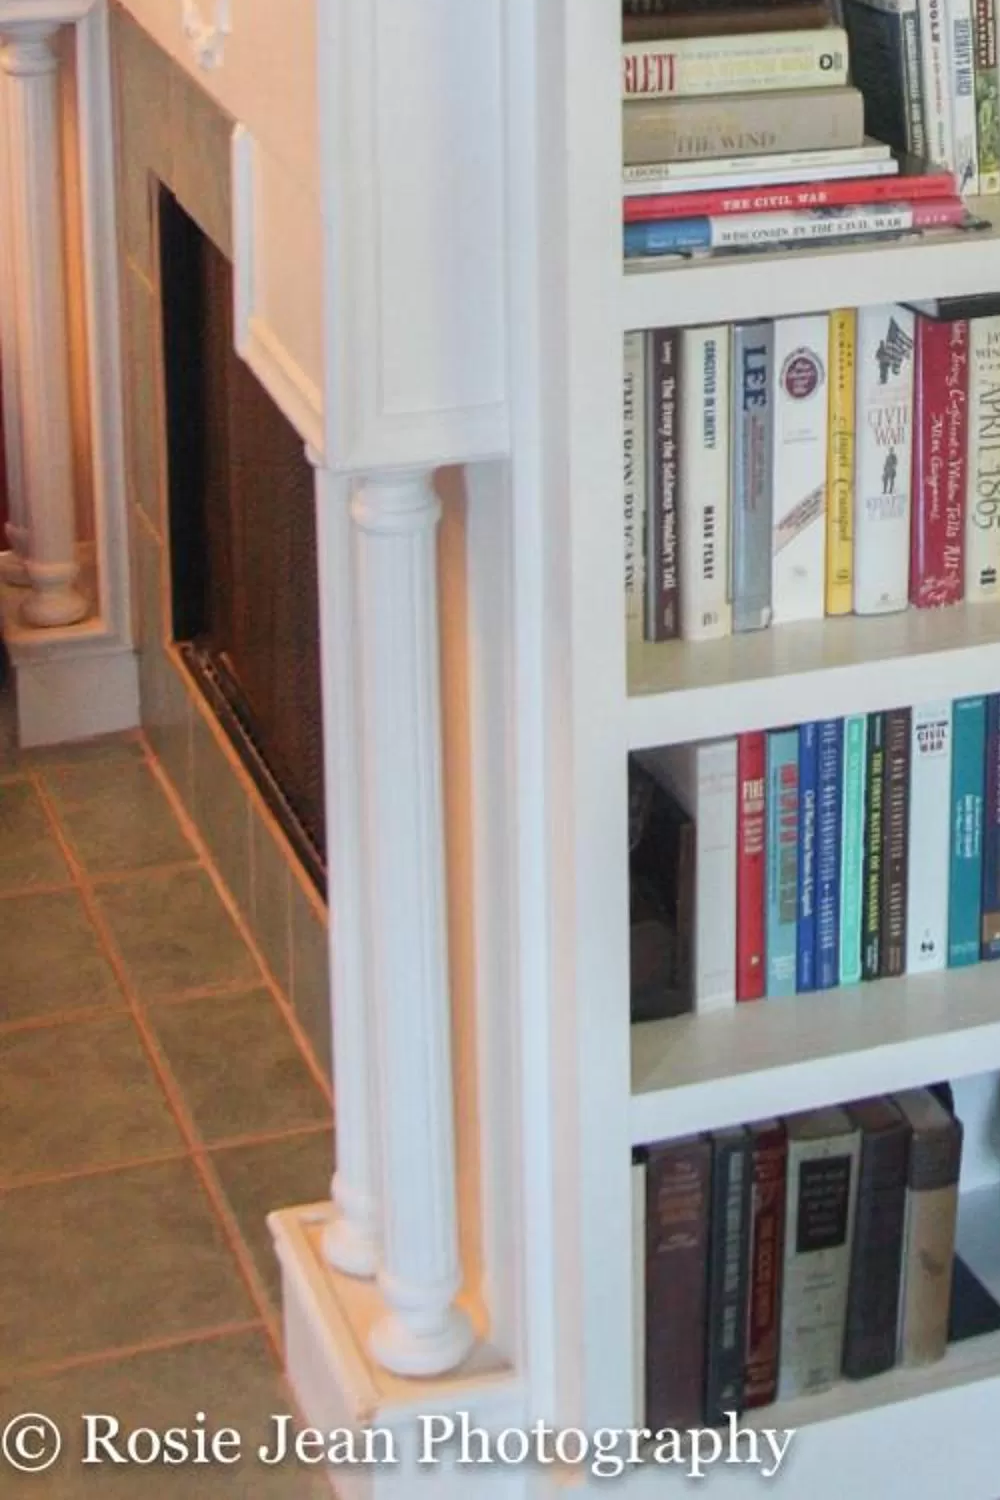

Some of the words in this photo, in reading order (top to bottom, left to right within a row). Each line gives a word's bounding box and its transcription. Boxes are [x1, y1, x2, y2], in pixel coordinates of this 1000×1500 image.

[722, 199, 749, 212] THE
[753, 195, 793, 208] CIVIL
[797, 191, 828, 204] WAR
[661, 377, 676, 399] The
[742, 344, 769, 412] LEE
[657, 401, 676, 437] Story
[702, 409, 717, 449] LIBERTY
[867, 406, 909, 429] CIVIL
[661, 440, 676, 459] the
[874, 426, 906, 447] WAR
[661, 461, 677, 511] Soldiers
[703, 505, 715, 539] MARK
[945, 503, 963, 538] Tells
[703, 542, 715, 580] PERRY
[943, 543, 962, 570] All
[662, 566, 677, 590] Tell
[916, 728, 949, 742] CIVIL
[919, 739, 945, 754] WAR
[871, 751, 883, 776] THE
[743, 778, 765, 798] FIRE
[871, 777, 883, 809] FIRST
[871, 812, 882, 854] BATTLE
[868, 873, 881, 933] MANASSAS
